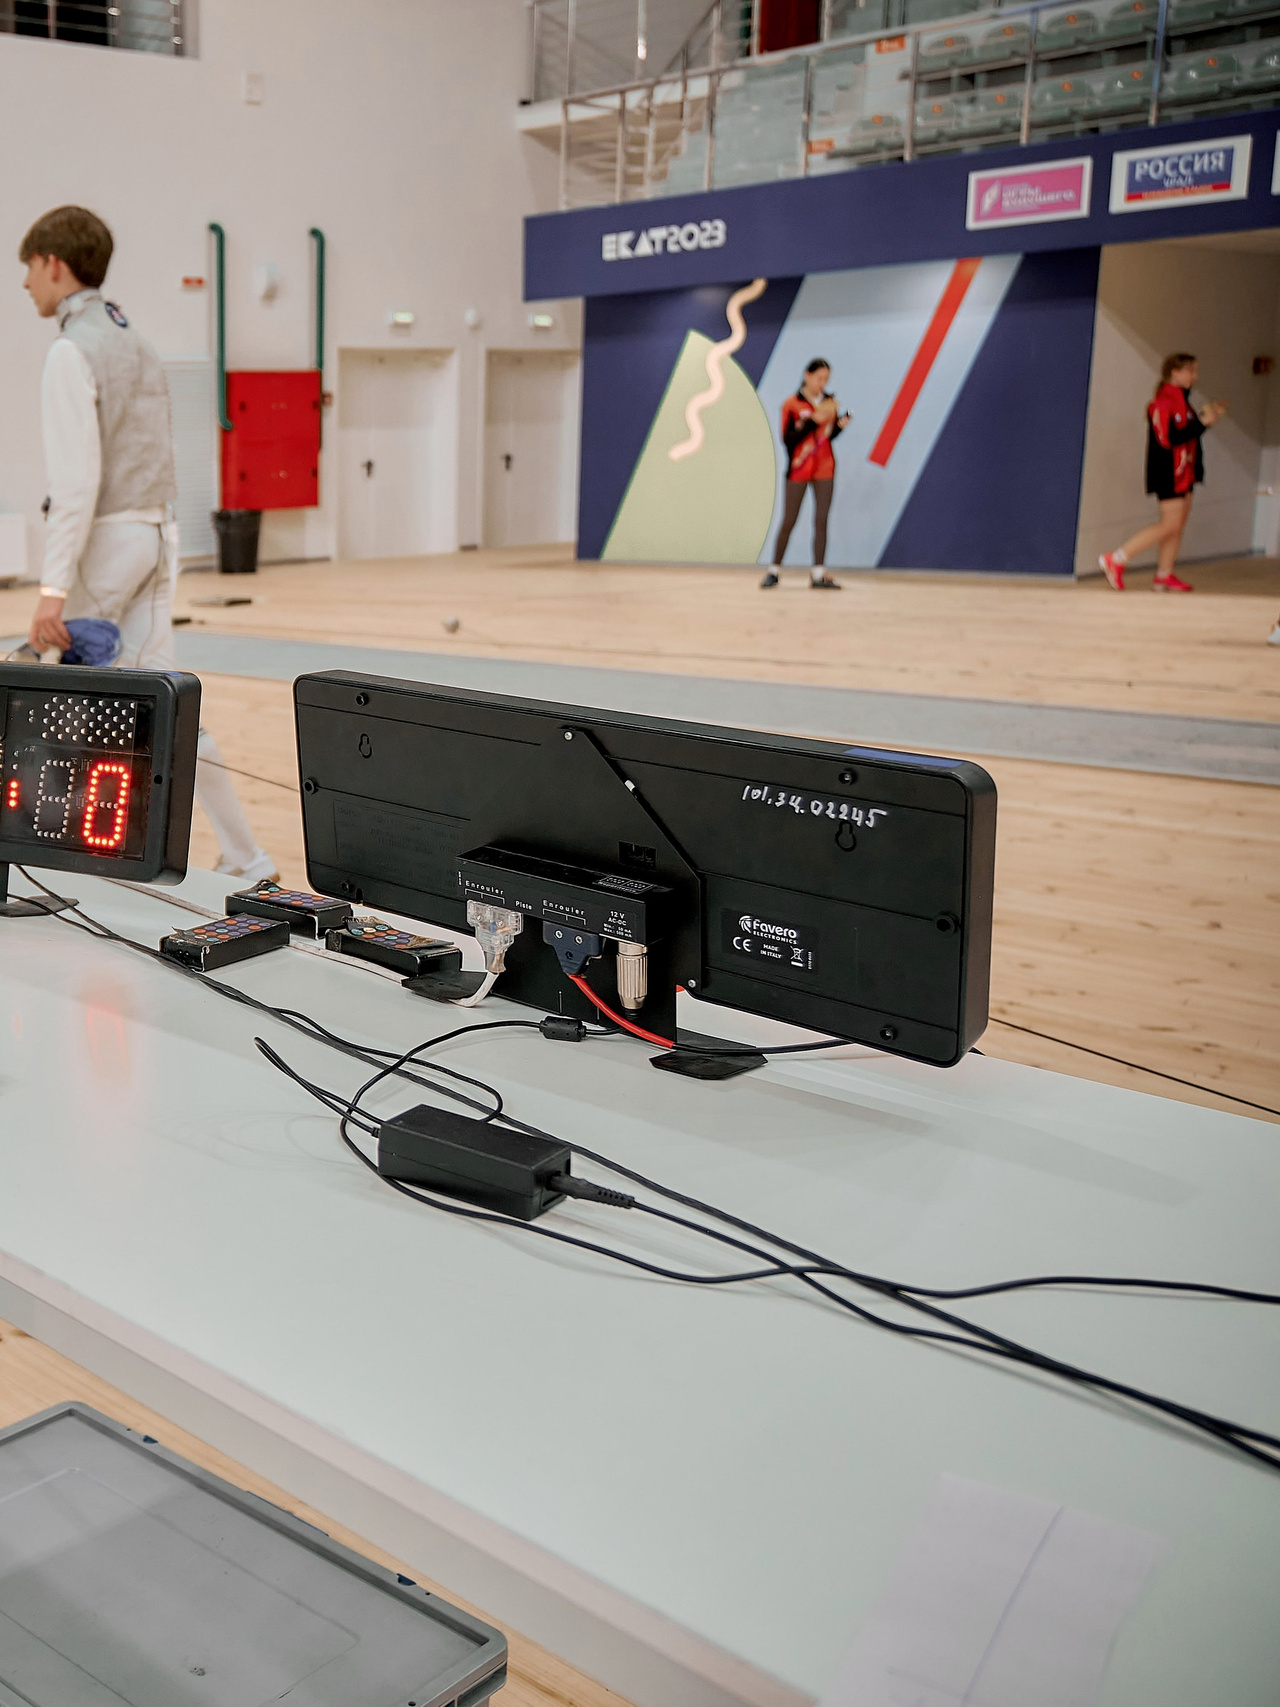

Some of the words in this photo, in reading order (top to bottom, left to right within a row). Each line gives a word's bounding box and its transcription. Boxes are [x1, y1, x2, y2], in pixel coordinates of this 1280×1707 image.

[1135, 151, 1226, 182] РОССИЯ
[82, 762, 130, 847] 0
[465, 880, 505, 896] Enrouler
[515, 900, 533, 911] Piste
[542, 899, 586, 916] Enrouler
[753, 918, 797, 939] Favero
[753, 931, 797, 945] ELECTRONICS
[763, 943, 780, 952] MADE
[767, 950, 782, 959] ITALY
